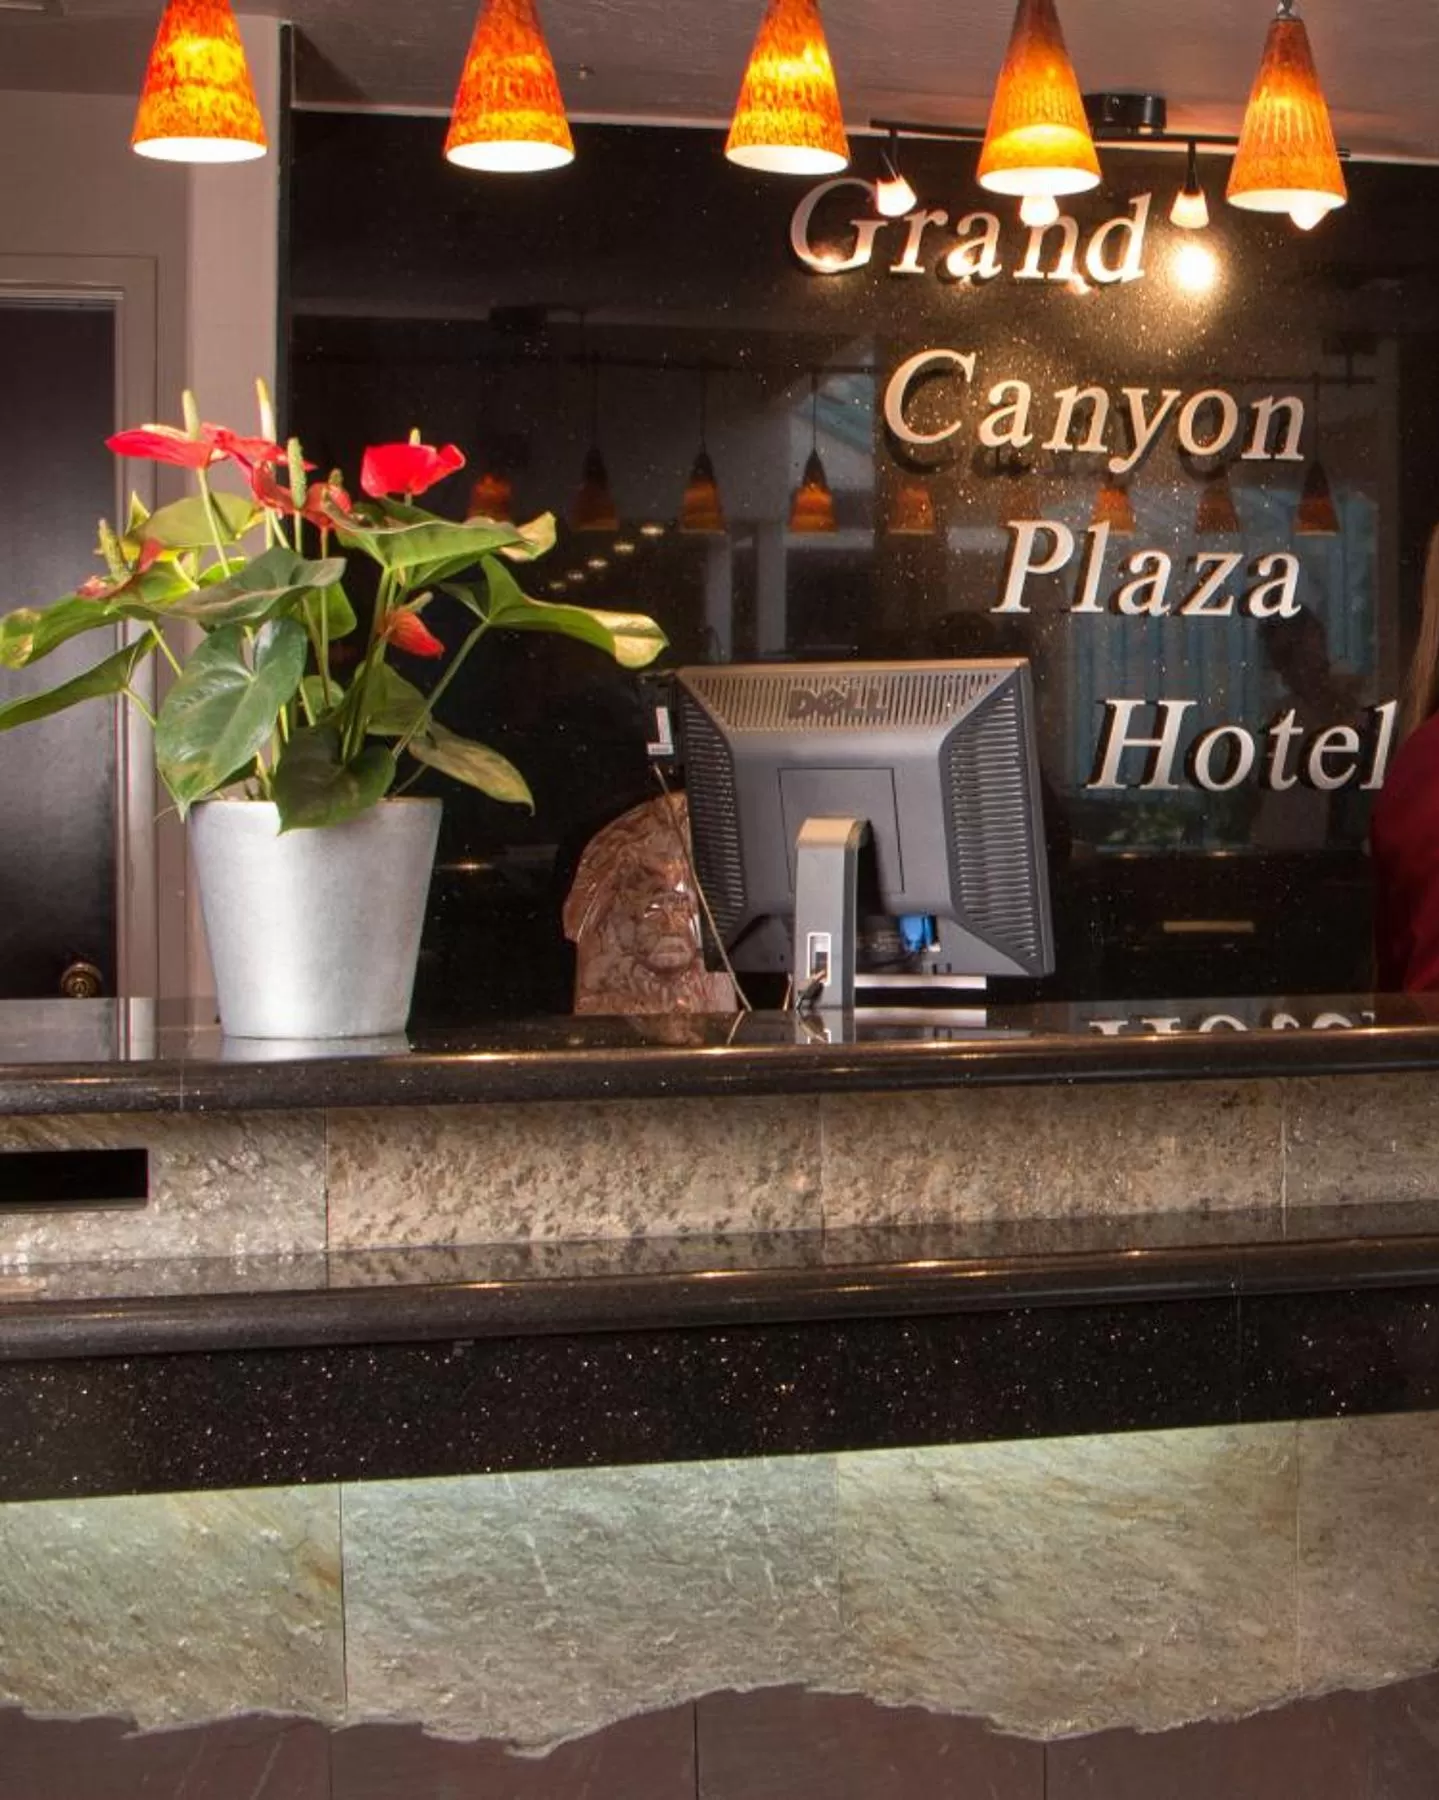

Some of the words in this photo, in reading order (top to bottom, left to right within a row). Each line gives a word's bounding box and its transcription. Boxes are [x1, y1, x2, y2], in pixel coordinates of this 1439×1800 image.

[790, 177, 1152, 284] Grand
[884, 348, 1305, 474] Canyon
[989, 519, 1302, 619] Plaza
[789, 687, 889, 719] DELL
[1086, 699, 1398, 791] Hotel
